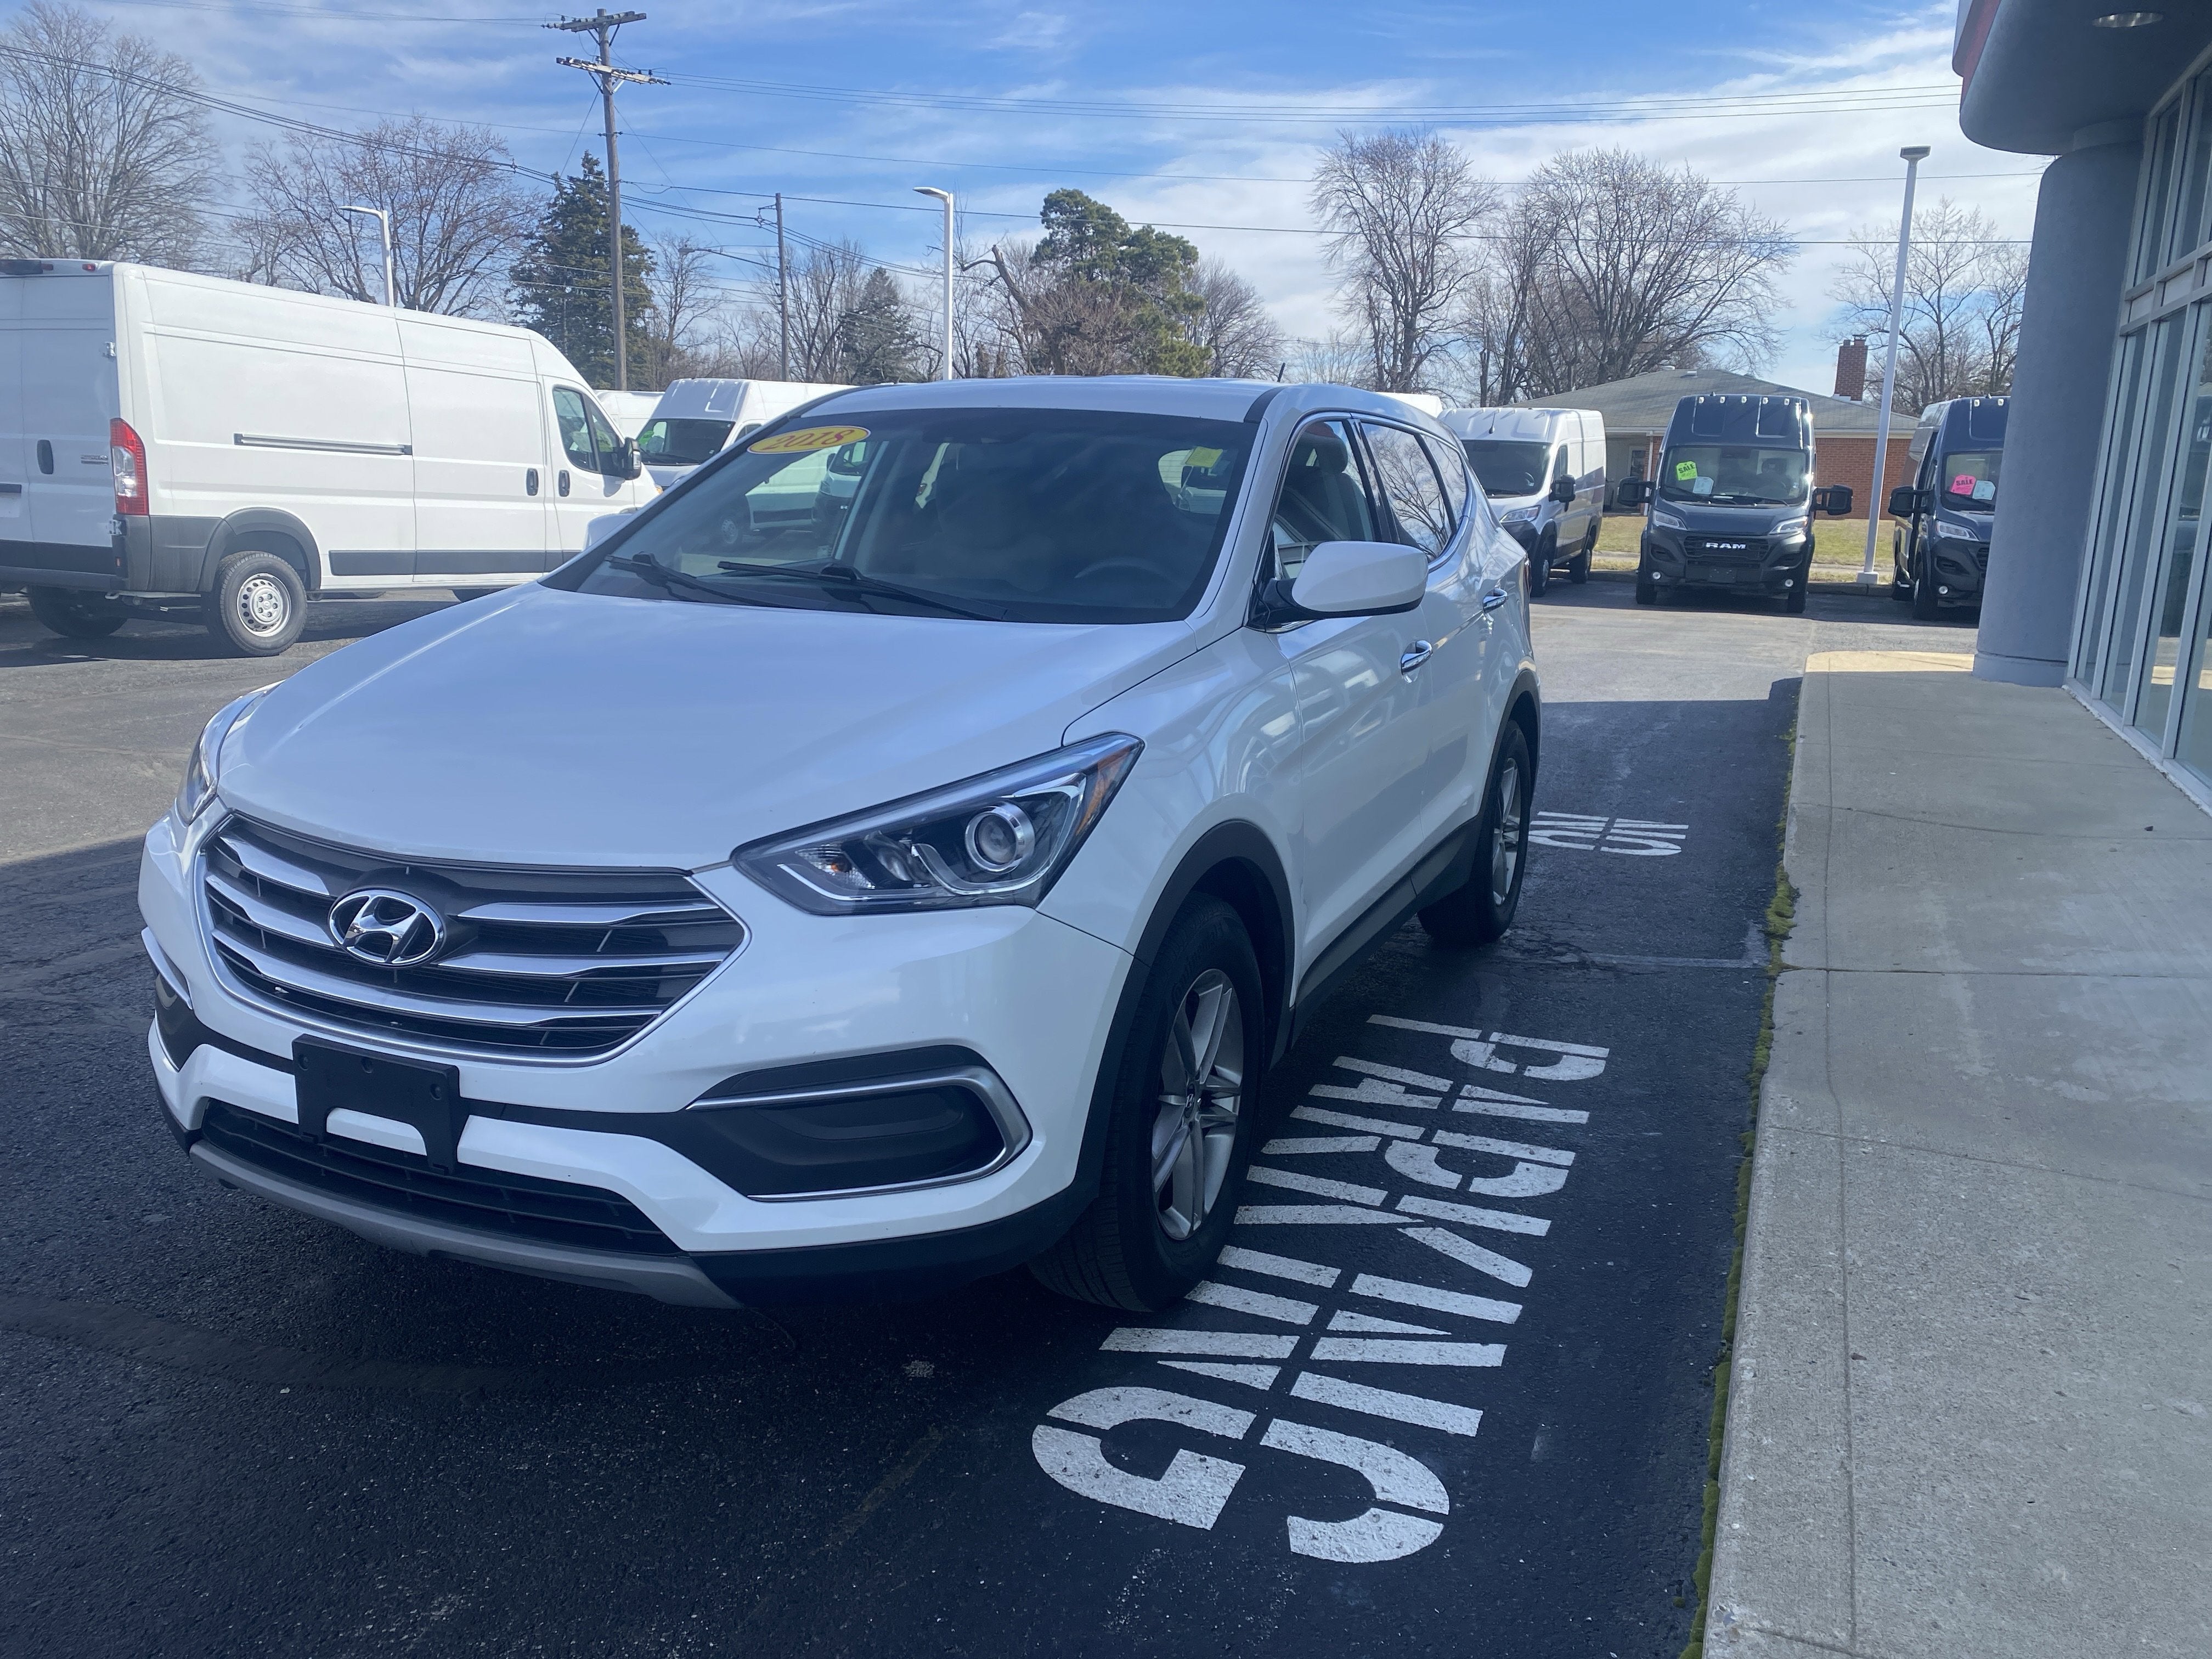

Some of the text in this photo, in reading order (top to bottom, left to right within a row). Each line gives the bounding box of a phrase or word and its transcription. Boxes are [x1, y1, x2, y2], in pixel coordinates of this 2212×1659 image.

[760, 430, 855, 450] 2018
[1678, 463, 1696, 473] SALE
[1031, 811, 1689, 1564] NO PARKING
